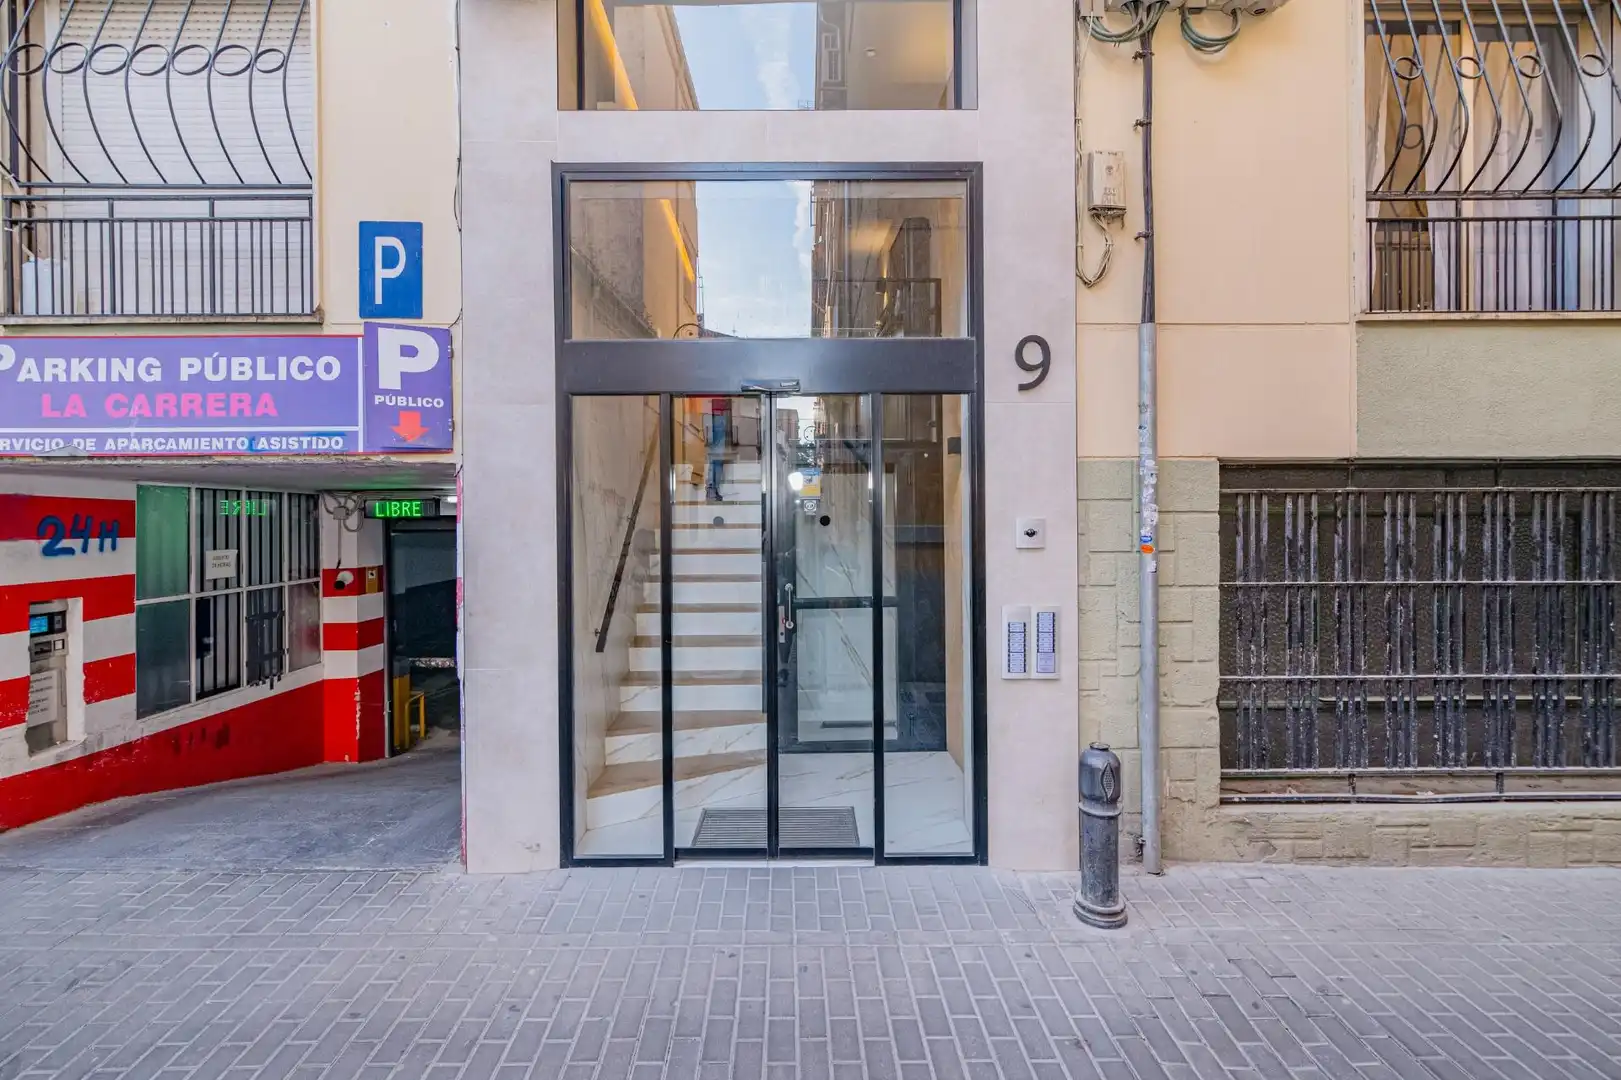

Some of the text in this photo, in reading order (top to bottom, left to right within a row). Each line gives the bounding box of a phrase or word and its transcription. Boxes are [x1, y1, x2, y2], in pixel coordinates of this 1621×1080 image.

[374, 236, 407, 305] P
[179, 352, 341, 382] PÚBLICO
[377, 326, 440, 390] P
[1014, 334, 1051, 391] 9
[41, 392, 278, 418] LA CARRERA
[374, 393, 444, 408] PÚBLICO
[73, 438, 97, 450] DE
[105, 437, 249, 451] APARCAMIENTO
[257, 436, 344, 450] ASISTIDO
[375, 501, 421, 517] LIBRE
